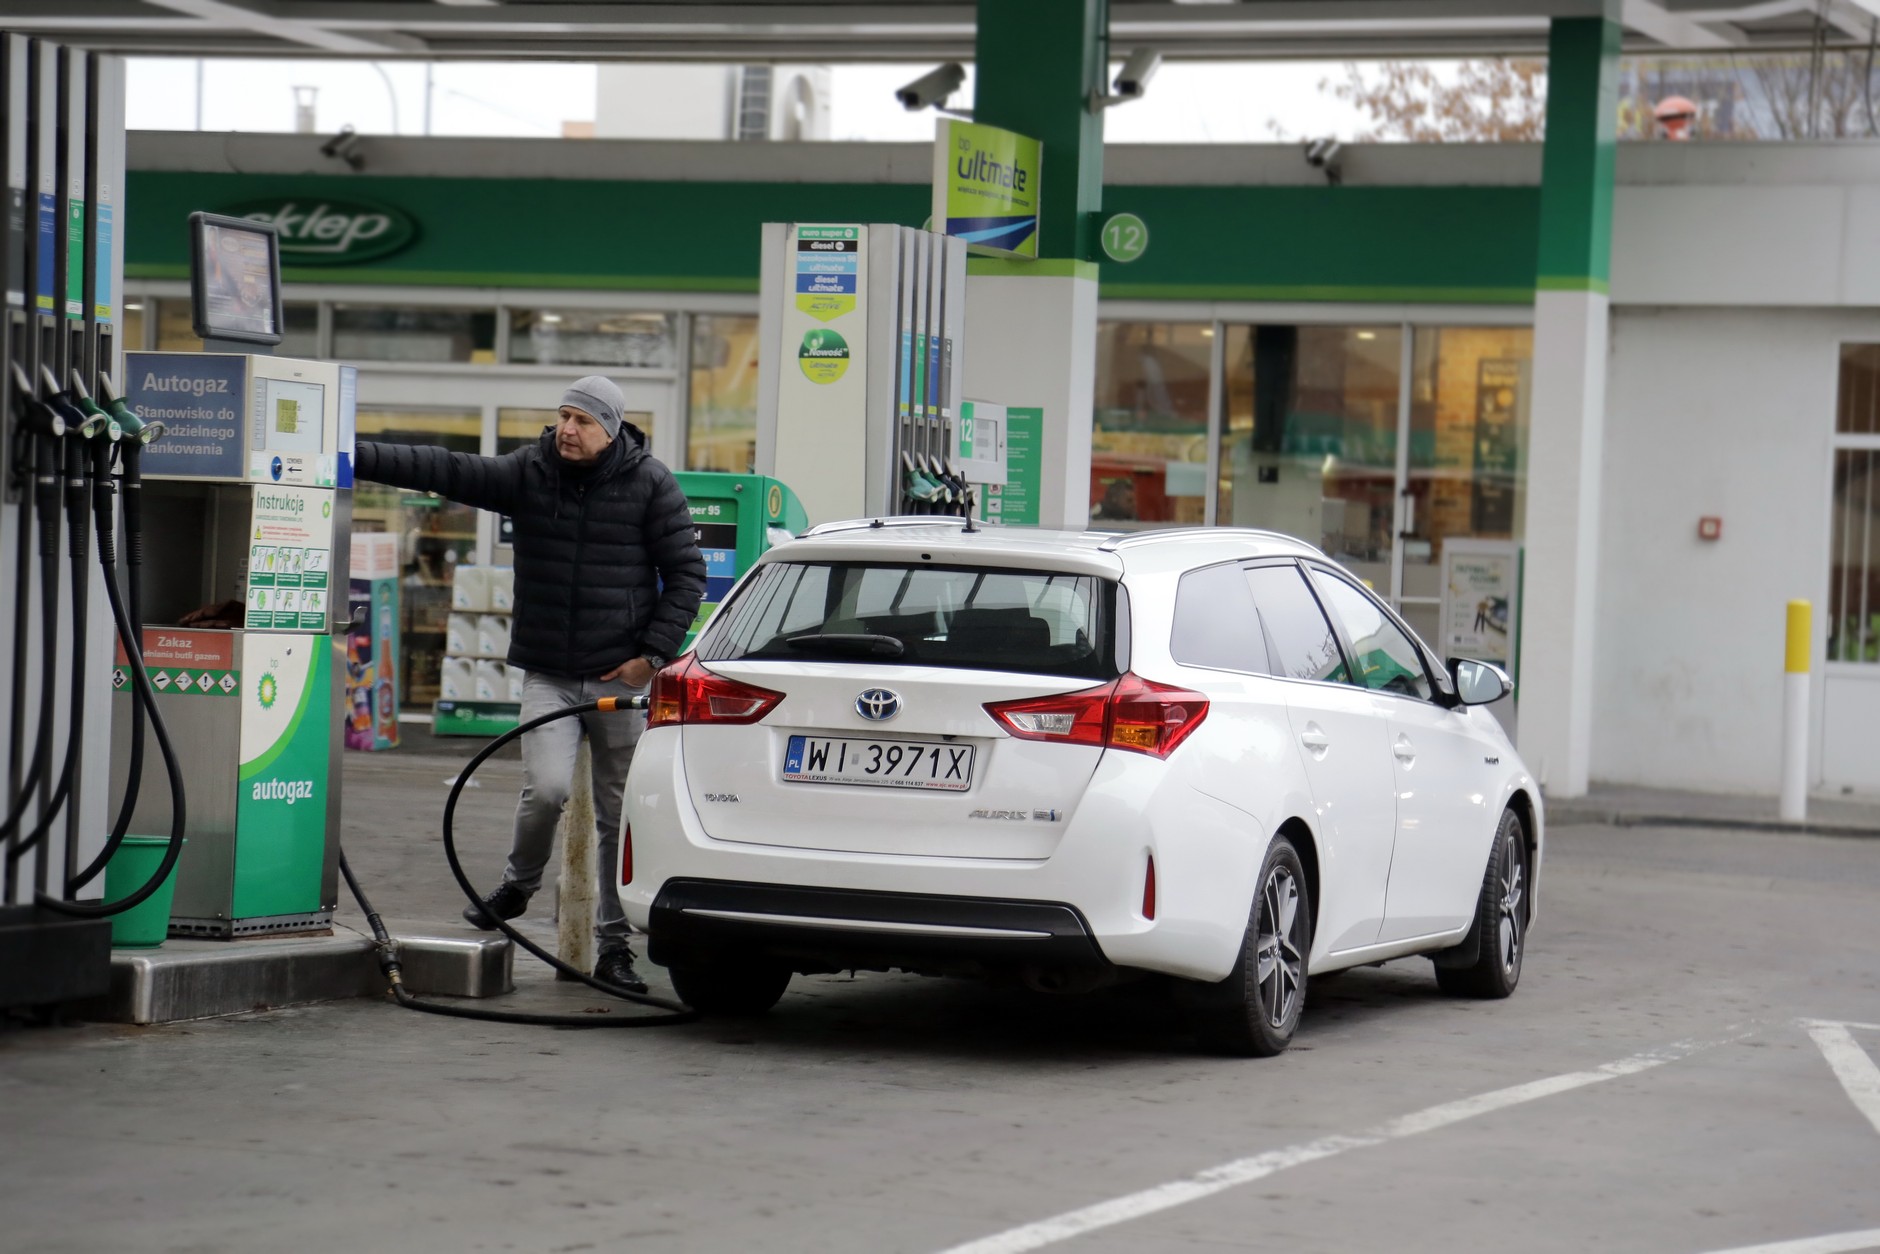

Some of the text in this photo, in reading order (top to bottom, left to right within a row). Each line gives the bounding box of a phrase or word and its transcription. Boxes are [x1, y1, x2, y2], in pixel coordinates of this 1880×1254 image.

[957, 150, 1027, 192] ultimate
[1109, 225, 1140, 250] 12
[810, 241, 835, 249] diesel
[814, 275, 838, 283] diesel
[808, 284, 844, 292] ultimate
[142, 372, 228, 396] Autogaz
[135, 405, 235, 420] Stanowisko do
[960, 418, 972, 442] 12
[145, 441, 223, 455] tankowania
[256, 491, 304, 515] Instrukcja
[708, 505, 720, 516] 95
[713, 552, 726, 562] 98
[157, 636, 192, 649] Zakaz
[175, 650, 193, 660] butli
[194, 652, 220, 662] gazem
[270, 658, 279, 669] bp
[788, 759, 800, 769] PL
[807, 741, 967, 780] WI 3971X
[252, 777, 313, 804] autogaz
[705, 794, 740, 802] TOYOTA
[969, 809, 1027, 820] AURIS
